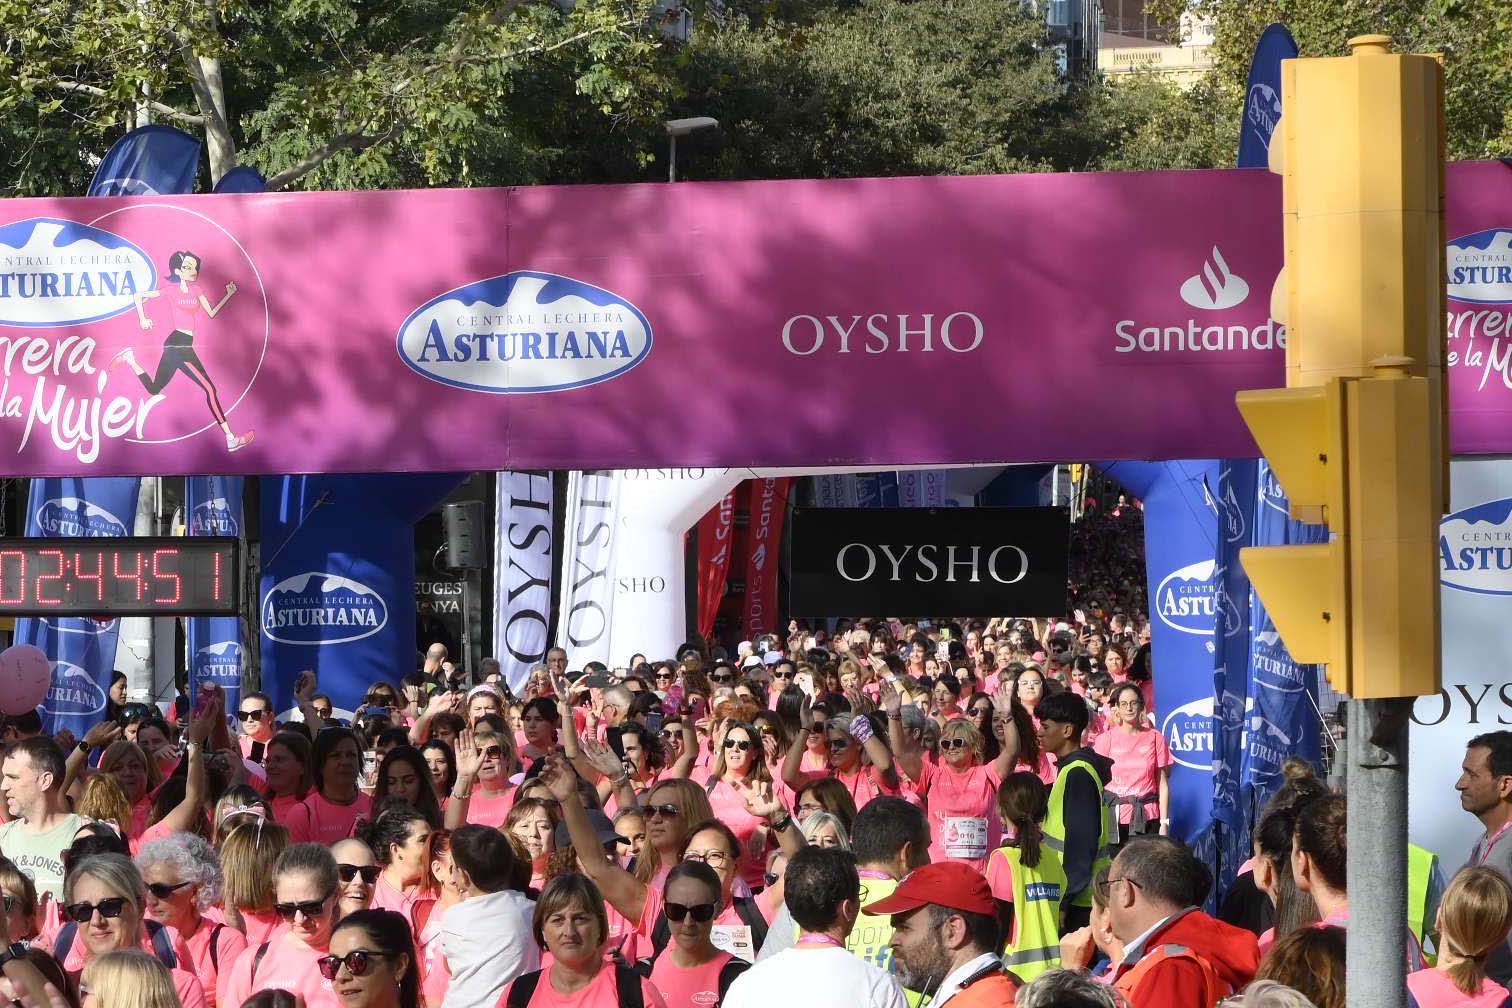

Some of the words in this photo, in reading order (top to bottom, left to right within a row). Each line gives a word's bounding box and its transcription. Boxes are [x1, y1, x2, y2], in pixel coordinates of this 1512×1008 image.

[456, 315, 535, 327] CENTRAL
[543, 312, 625, 325] LECHERA
[780, 311, 985, 356] OYSHO
[1114, 318, 1288, 354] Santande
[416, 317, 633, 364] ASTURIANA
[1464, 339, 1483, 367] la
[17, 369, 167, 464] Mujer
[836, 543, 1029, 585] OYSHO
[265, 601, 379, 630] ASTURIANA
[29, 855, 65, 877] JONES
